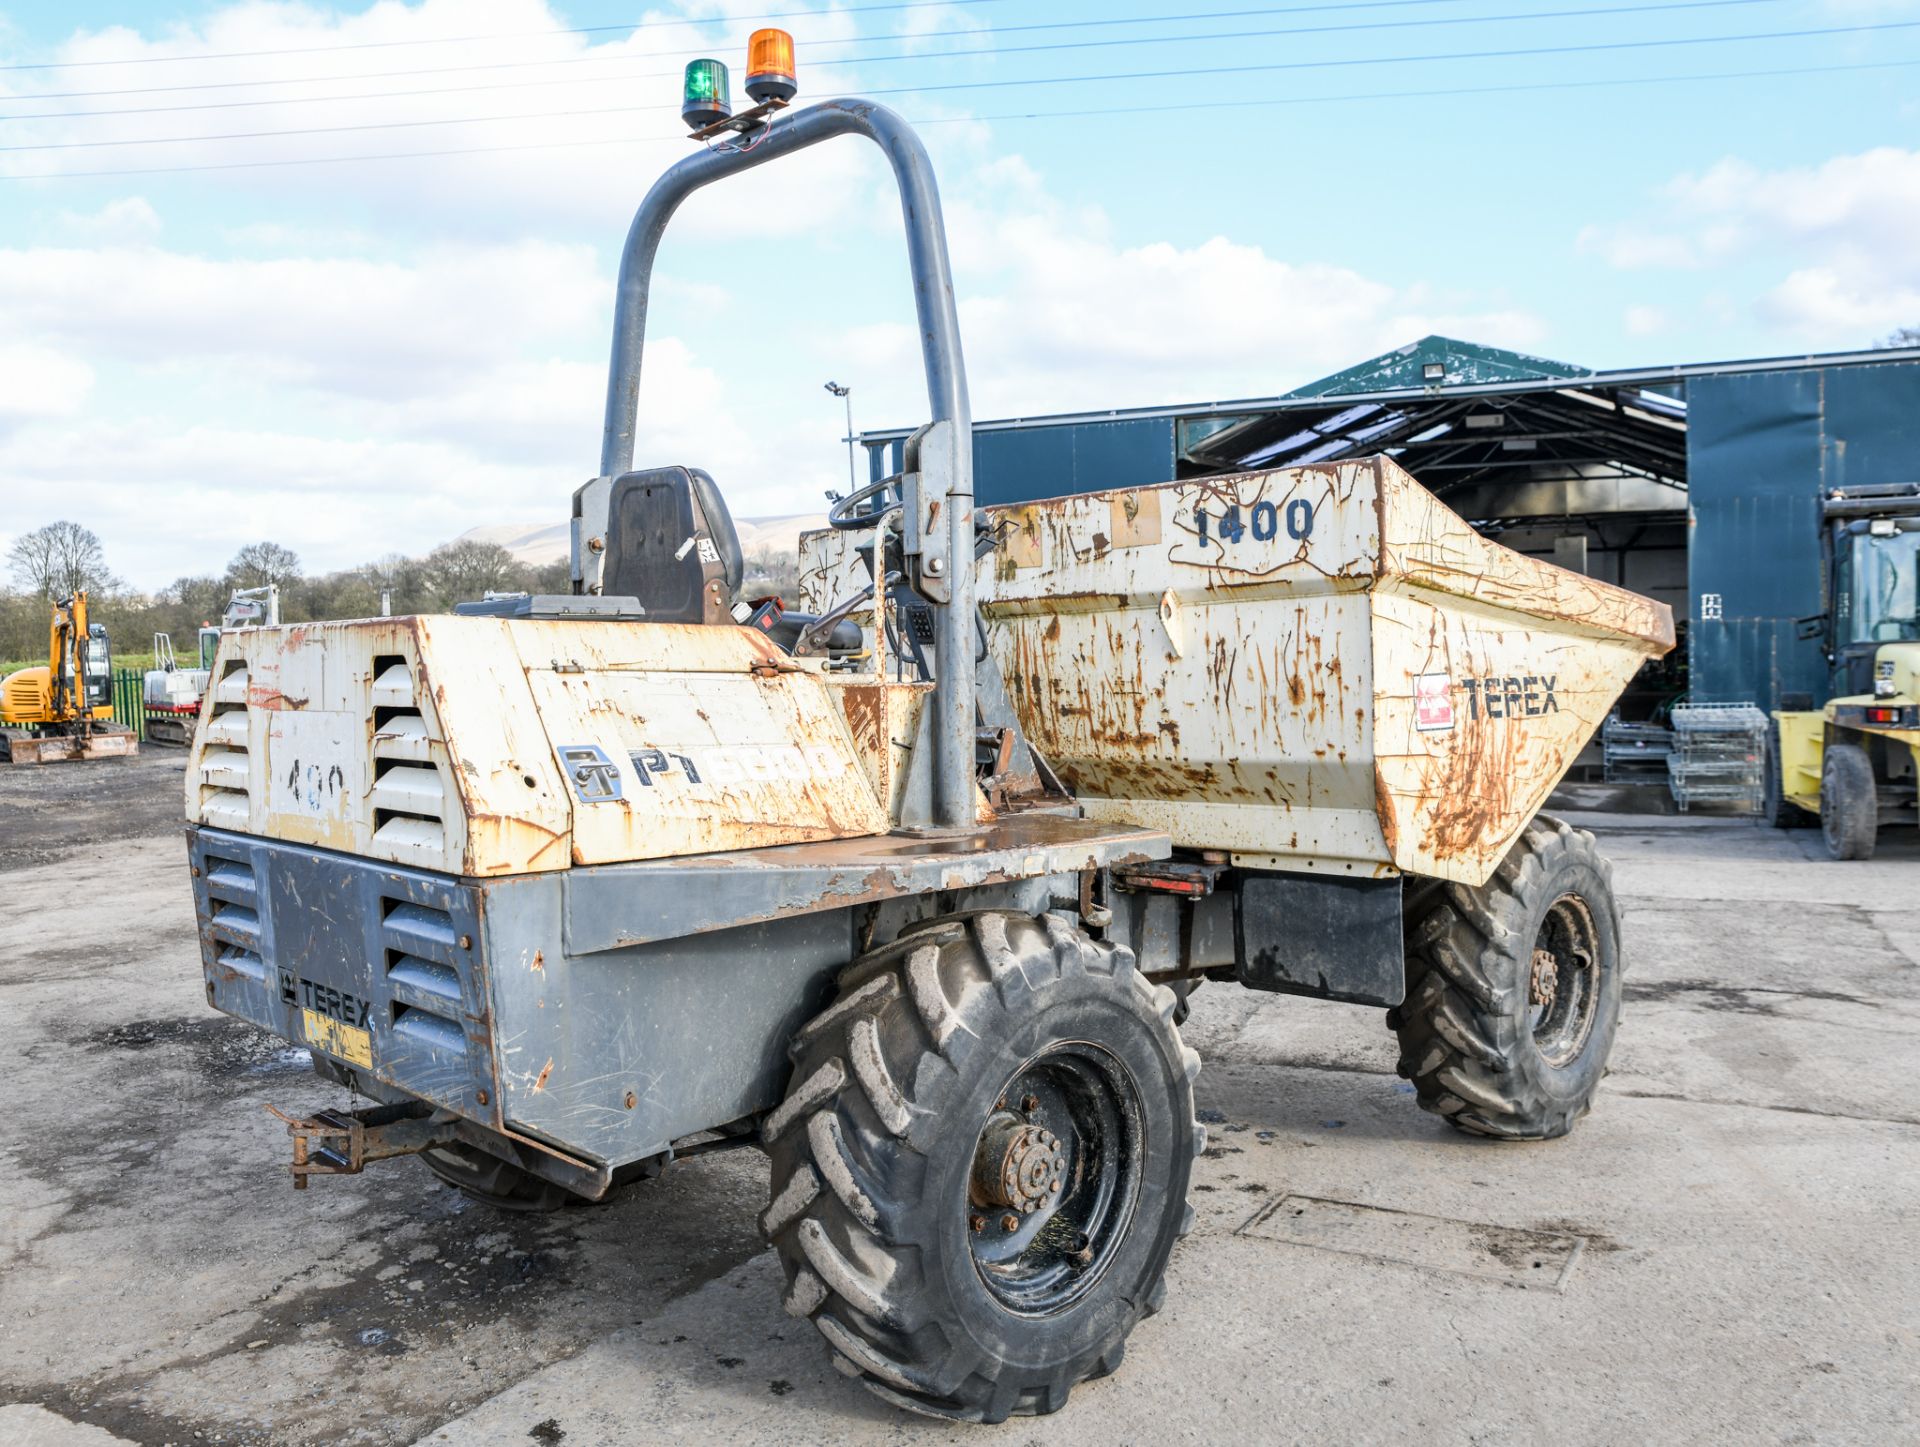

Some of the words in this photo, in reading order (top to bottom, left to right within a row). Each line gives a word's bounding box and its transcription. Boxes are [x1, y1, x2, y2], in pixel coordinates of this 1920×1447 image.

[1194, 499, 1313, 547] 1400
[1462, 675, 1559, 721] TEREX
[299, 977, 371, 1028] TEREX
